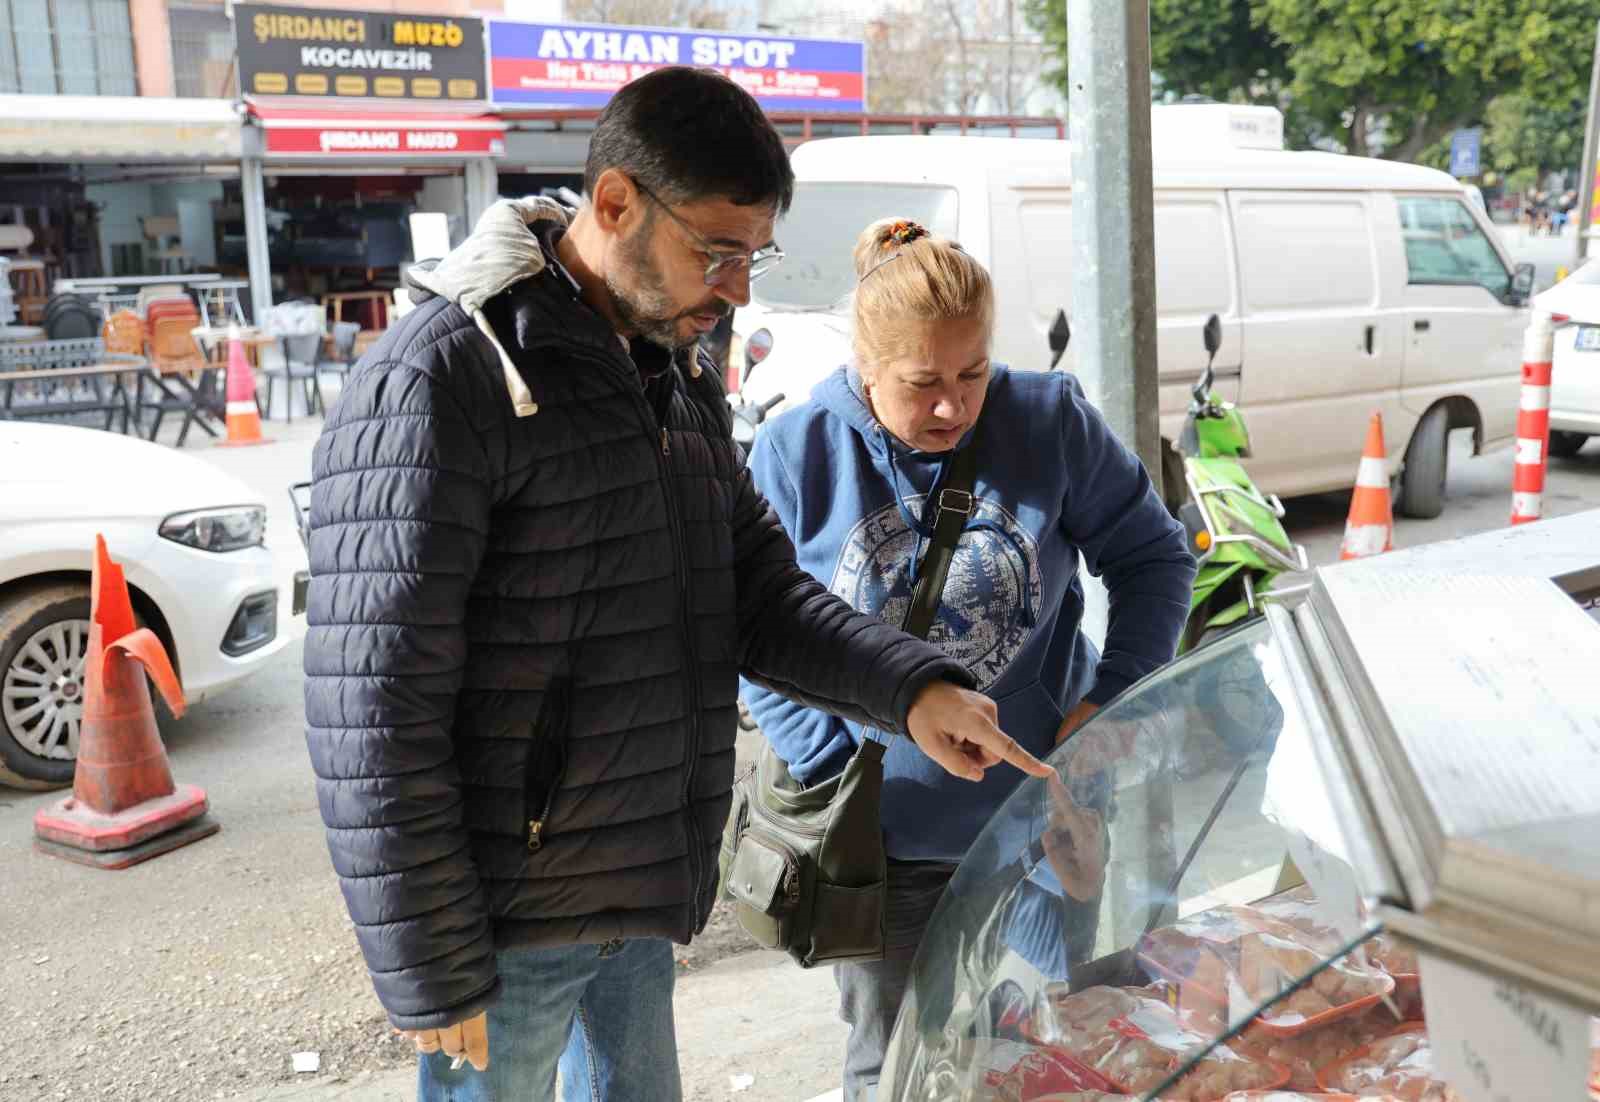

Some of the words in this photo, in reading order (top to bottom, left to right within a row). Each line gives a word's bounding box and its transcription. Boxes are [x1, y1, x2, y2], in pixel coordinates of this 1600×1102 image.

[253, 14, 365, 43] ŞIRDANCI
[301, 46, 432, 70] KOCAVEZİR
[538, 29, 679, 64] AYHAN
[692, 37, 795, 68] SPOT
